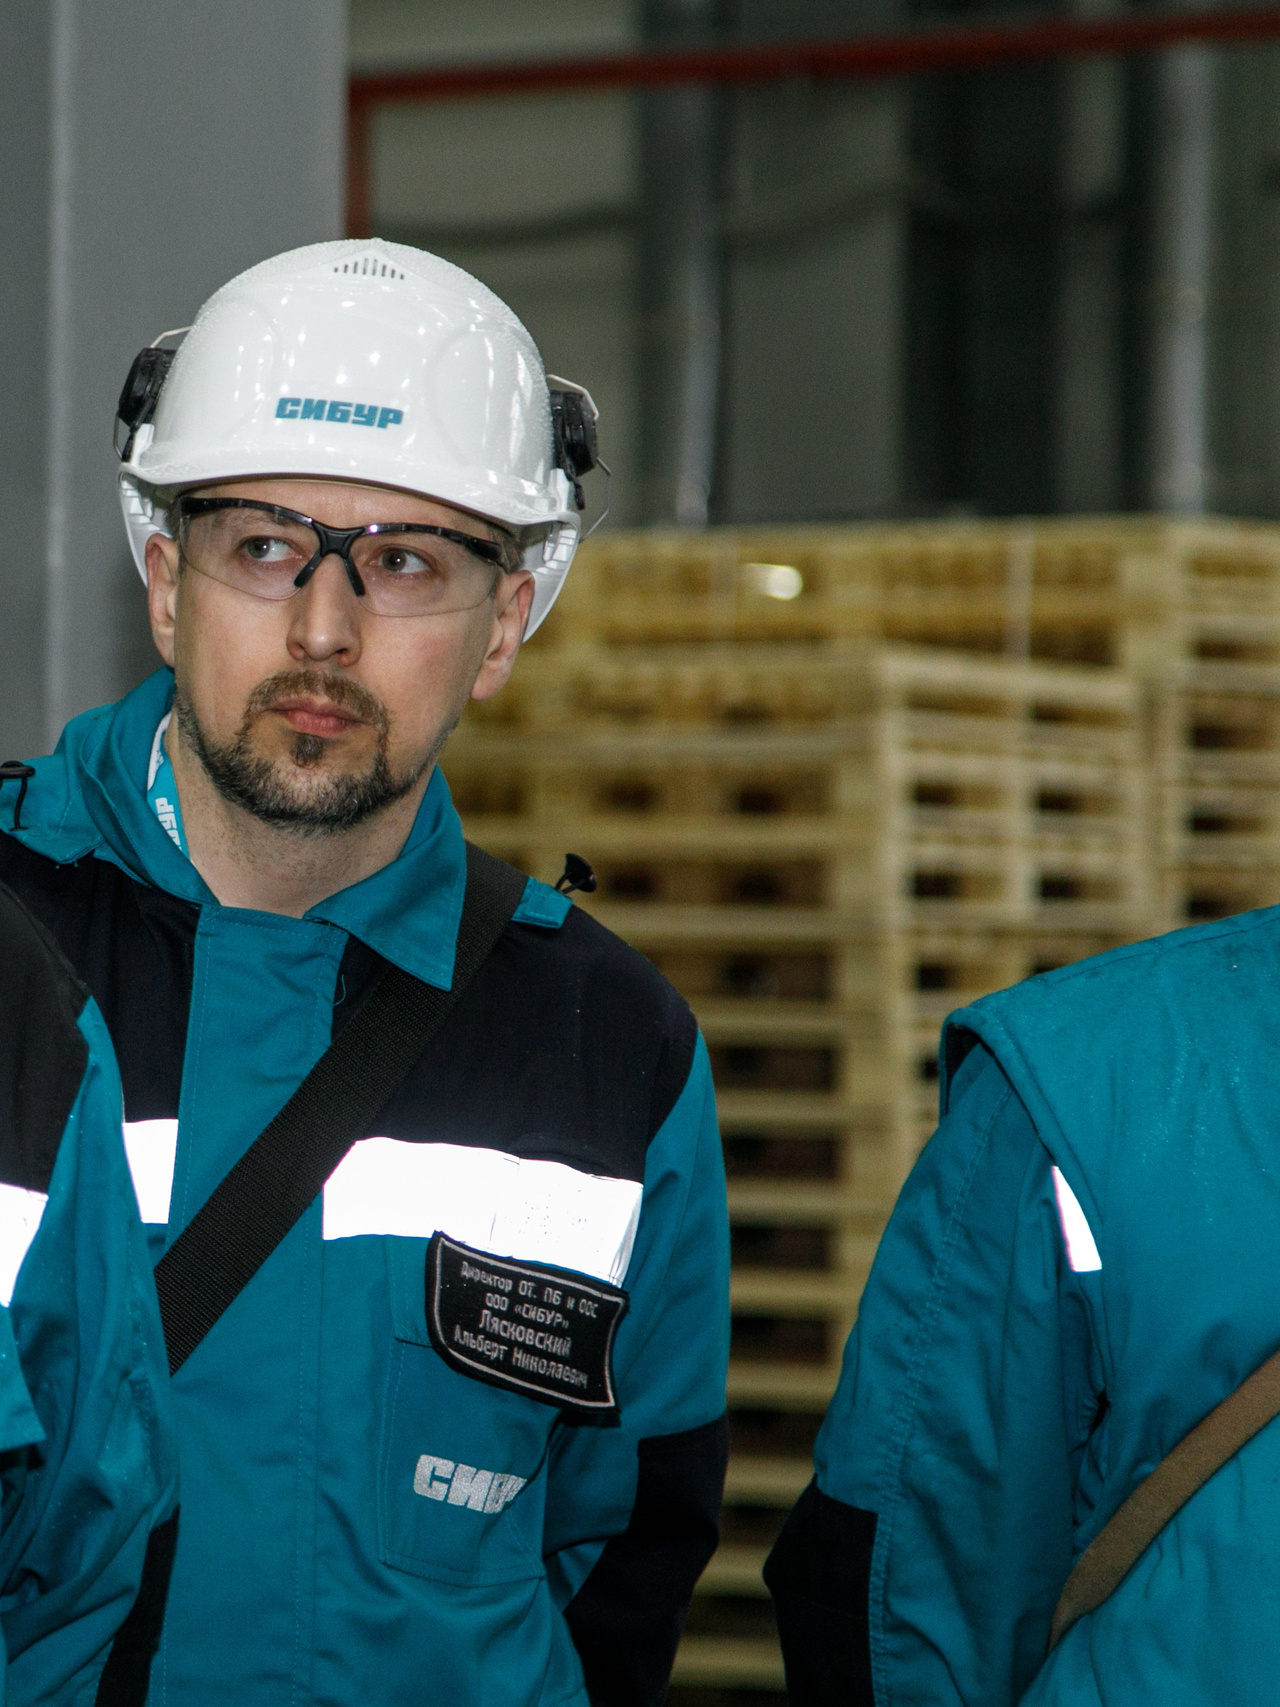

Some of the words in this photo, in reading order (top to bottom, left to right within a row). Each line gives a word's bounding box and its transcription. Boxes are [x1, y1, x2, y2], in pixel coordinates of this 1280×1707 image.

[275, 397, 404, 429] СИБУР
[461, 1261, 513, 1293] Директор
[544, 1287, 563, 1306] ПБ
[485, 1292, 509, 1312] ООО
[479, 1309, 572, 1358] Лясковский
[454, 1324, 509, 1361] Альберт
[512, 1346, 589, 1390] Николаевич
